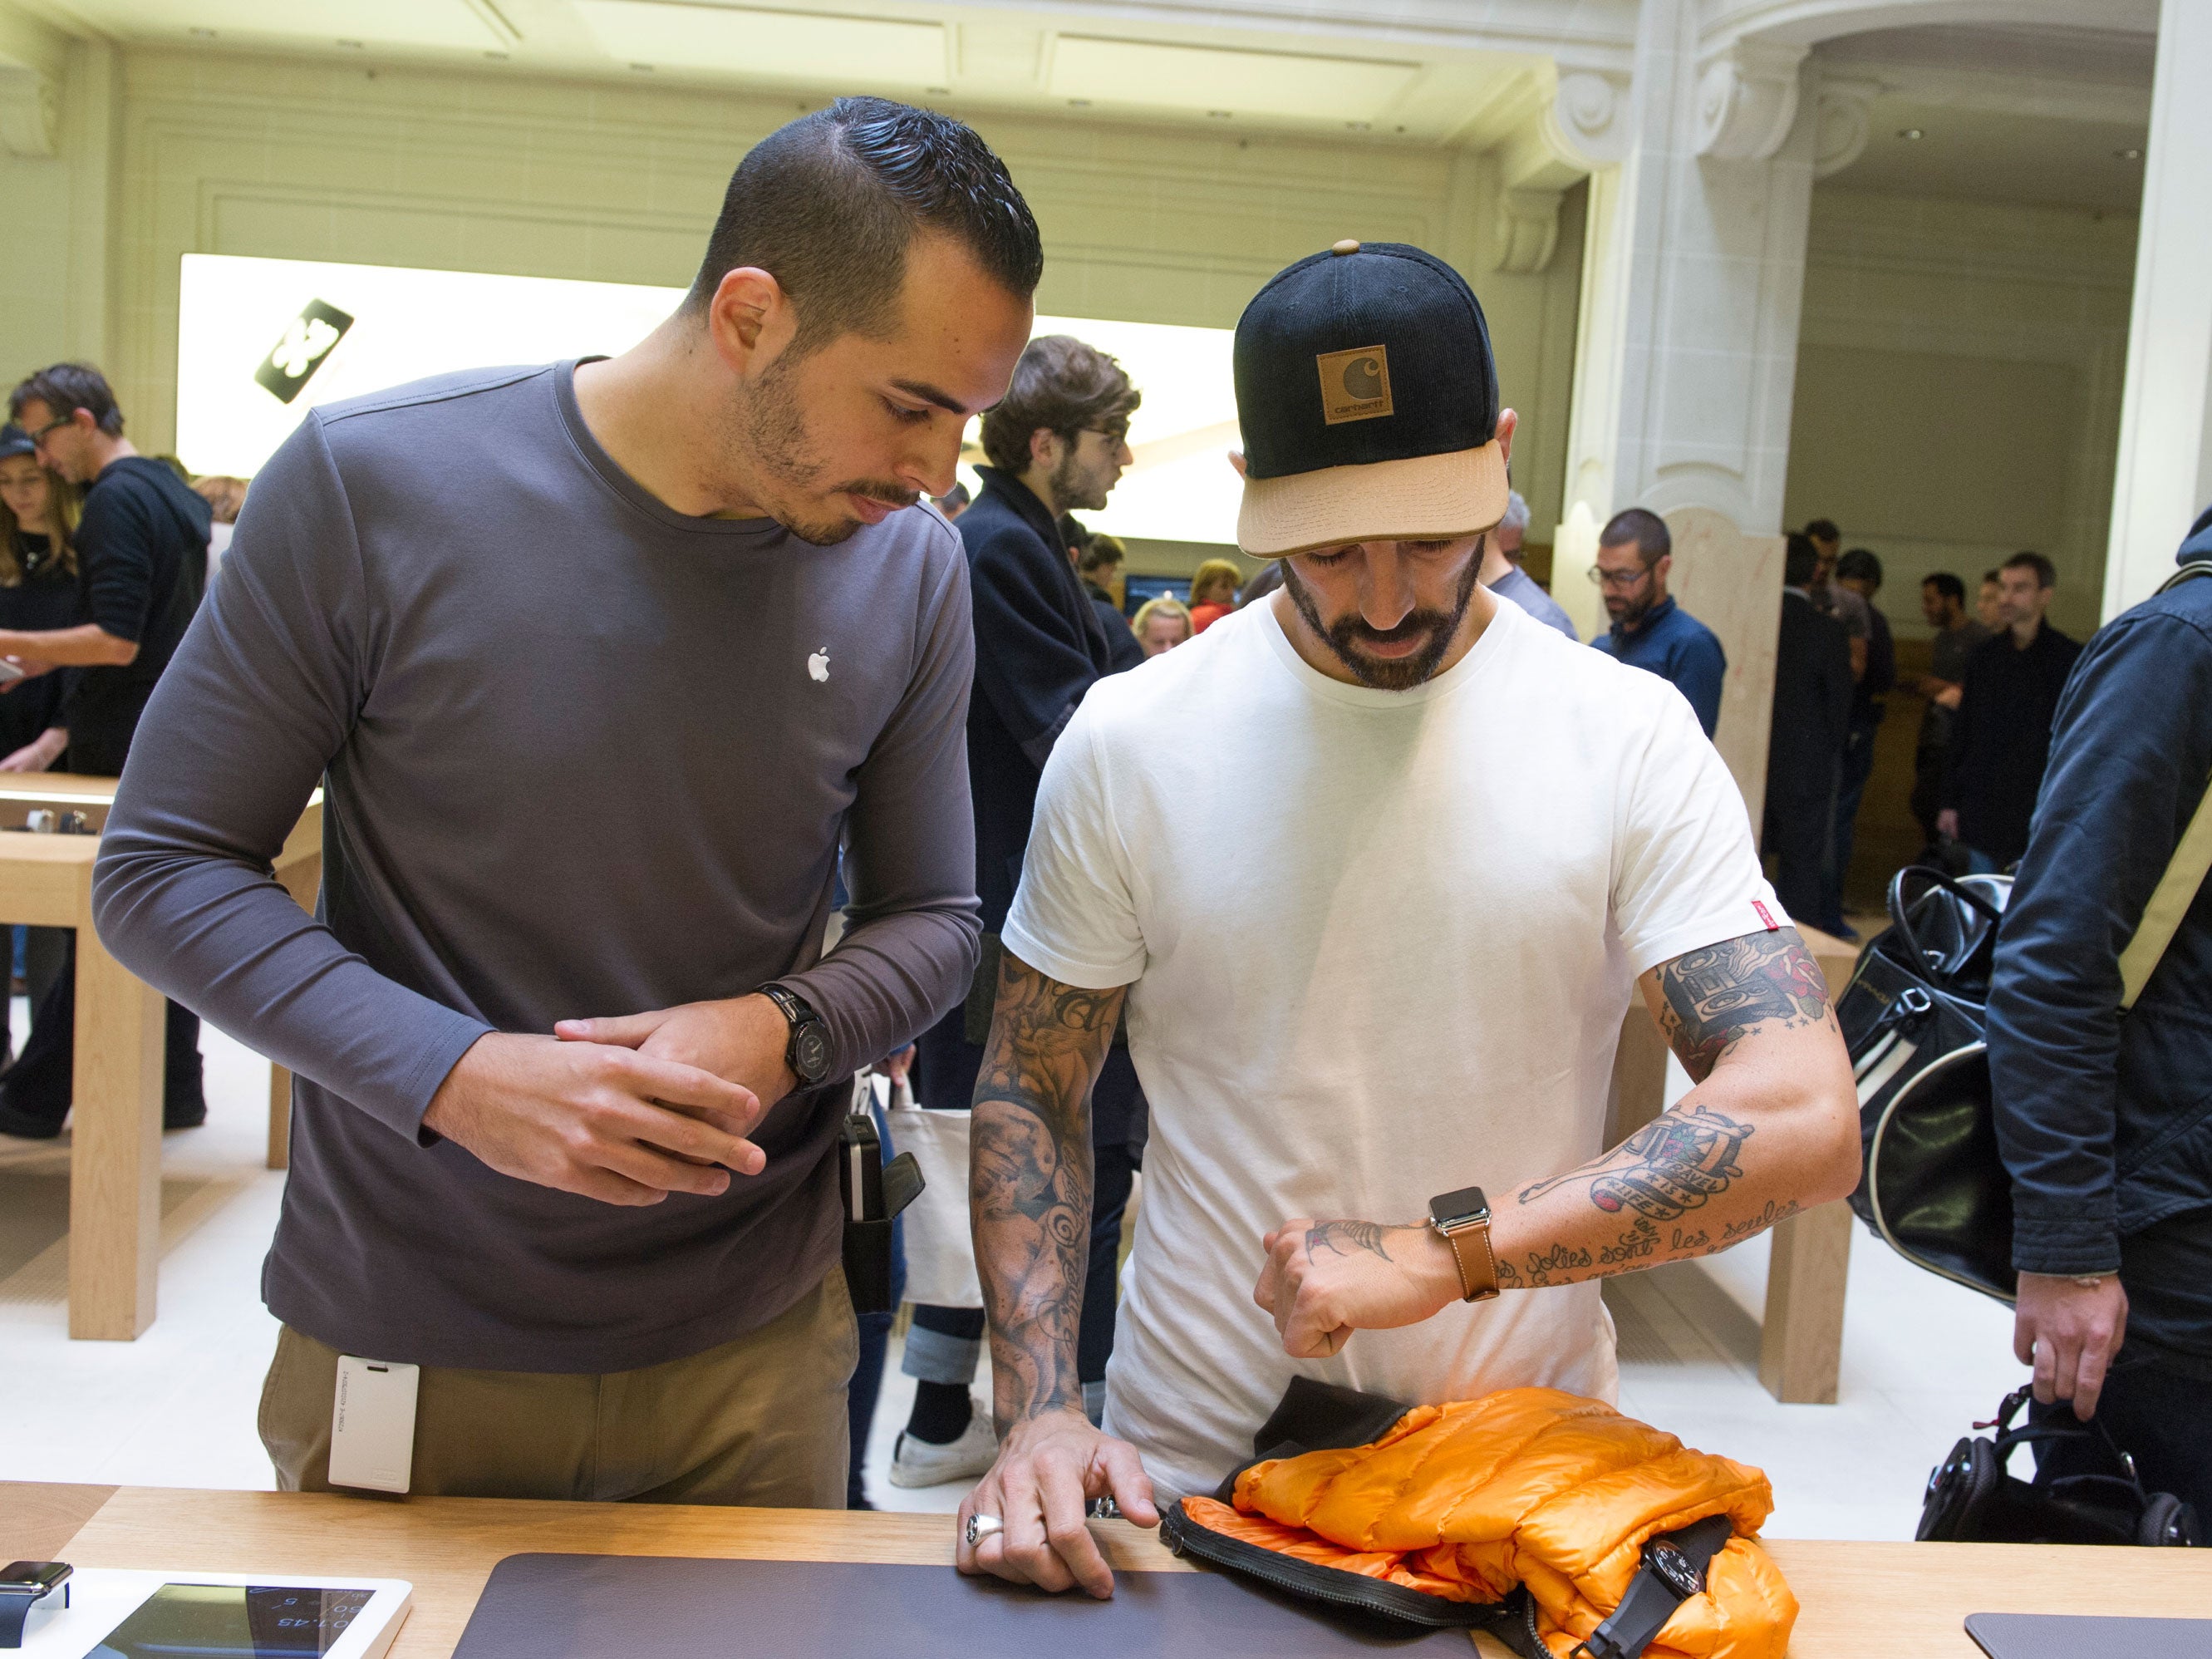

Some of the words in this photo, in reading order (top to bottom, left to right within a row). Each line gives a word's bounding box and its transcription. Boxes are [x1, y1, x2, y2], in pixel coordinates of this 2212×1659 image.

[1335, 401, 1384, 414] carhartt
[1660, 1180, 1679, 1195] IS
[1615, 1184, 1654, 1213] LIFE
[1669, 1228, 1712, 1252] les
